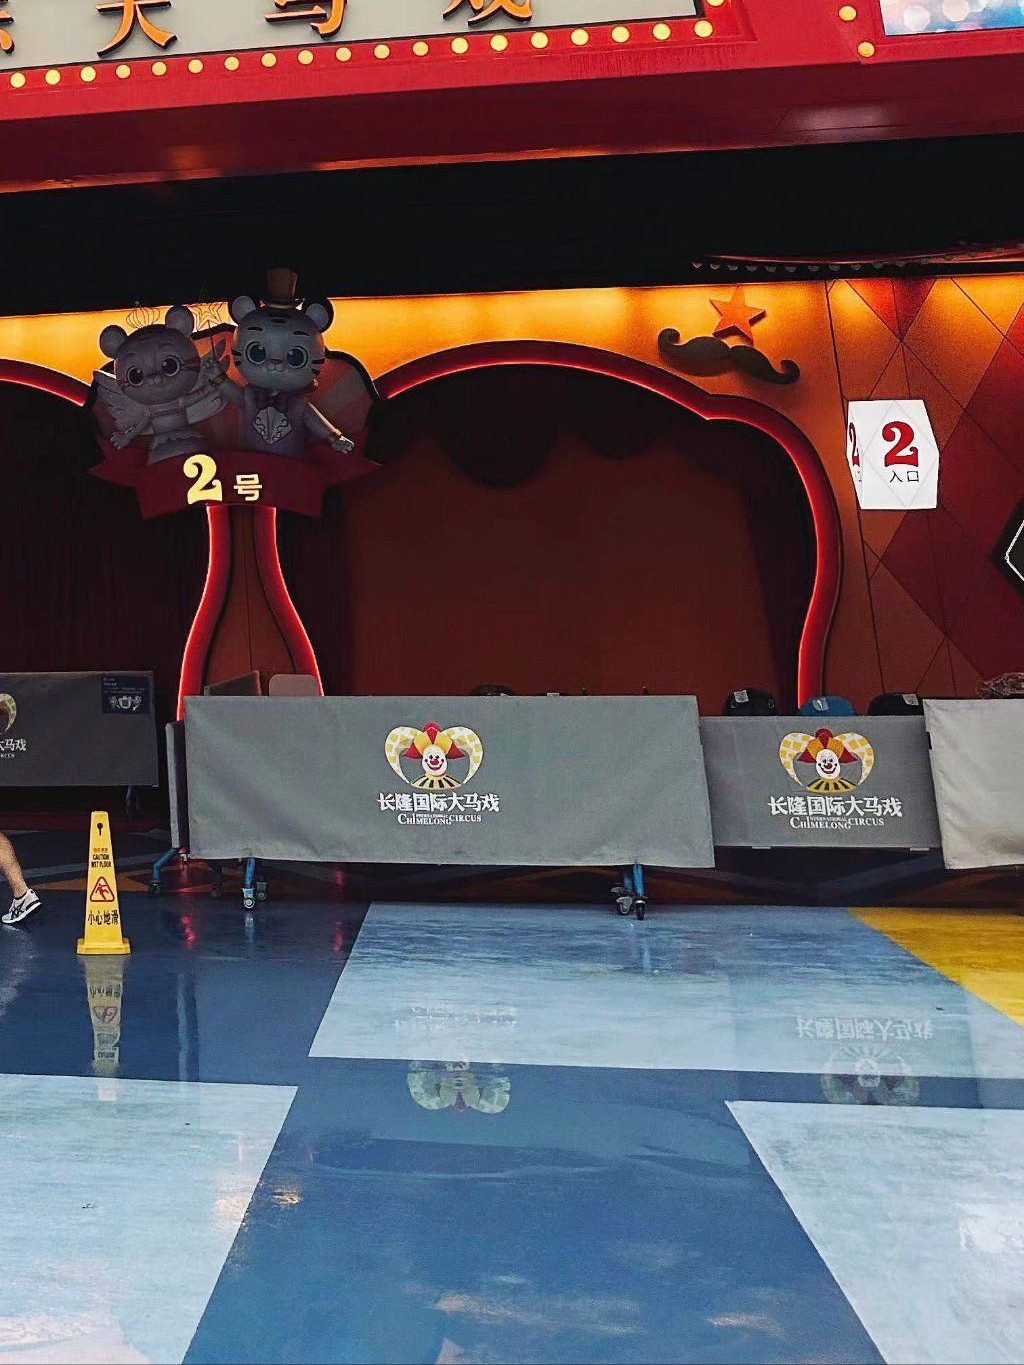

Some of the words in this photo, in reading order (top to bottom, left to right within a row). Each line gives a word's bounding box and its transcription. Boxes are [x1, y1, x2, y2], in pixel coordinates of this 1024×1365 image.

[882, 421, 919, 467] 2
[889, 470, 920, 483] 入口
[377, 792, 500, 812] 长隆国际大马戏
[767, 795, 903, 817] 长隆国际大马戏
[449, 814, 482, 822] CIRCUS
[849, 817, 885, 827] CIRCUS
[87, 909, 119, 926] 小心地滑
